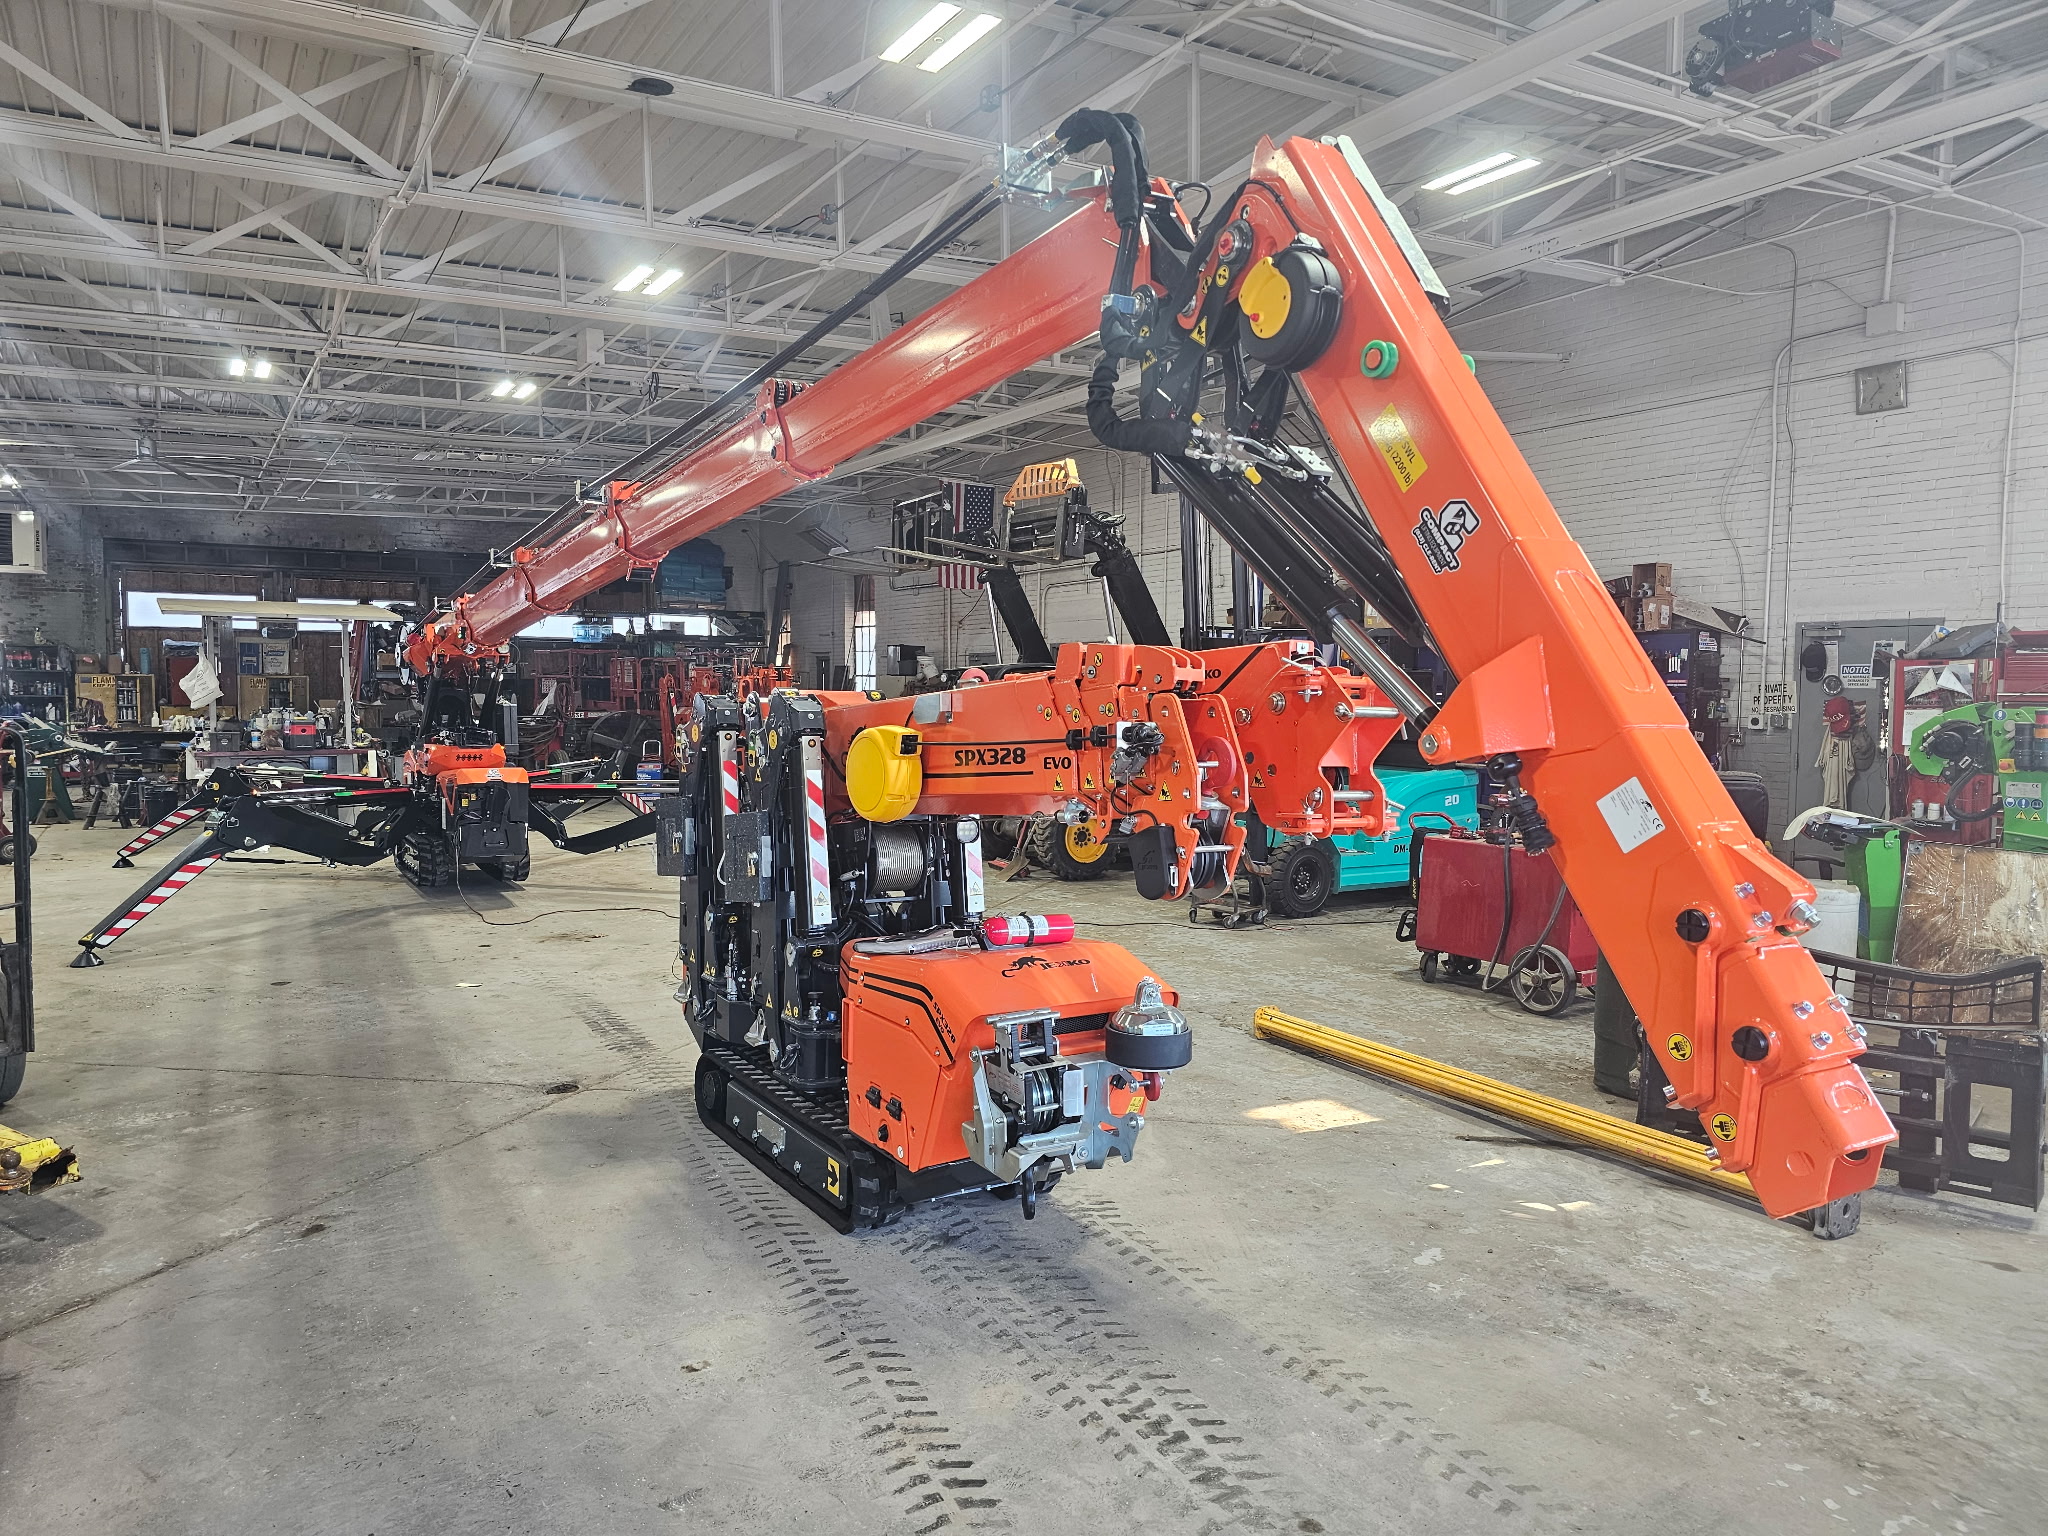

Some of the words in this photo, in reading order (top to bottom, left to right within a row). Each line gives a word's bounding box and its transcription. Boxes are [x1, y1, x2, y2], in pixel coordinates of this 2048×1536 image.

[1402, 441, 1416, 464] SWL
[1403, 471, 1414, 487] lb)
[1422, 510, 1457, 568] COMPACT
[1843, 666, 1871, 674] NOTIC
[954, 747, 1026, 767] SPX328
[1043, 756, 1072, 770] EVO
[1444, 794, 1460, 807] 20
[932, 1001, 956, 1045] SPX328
